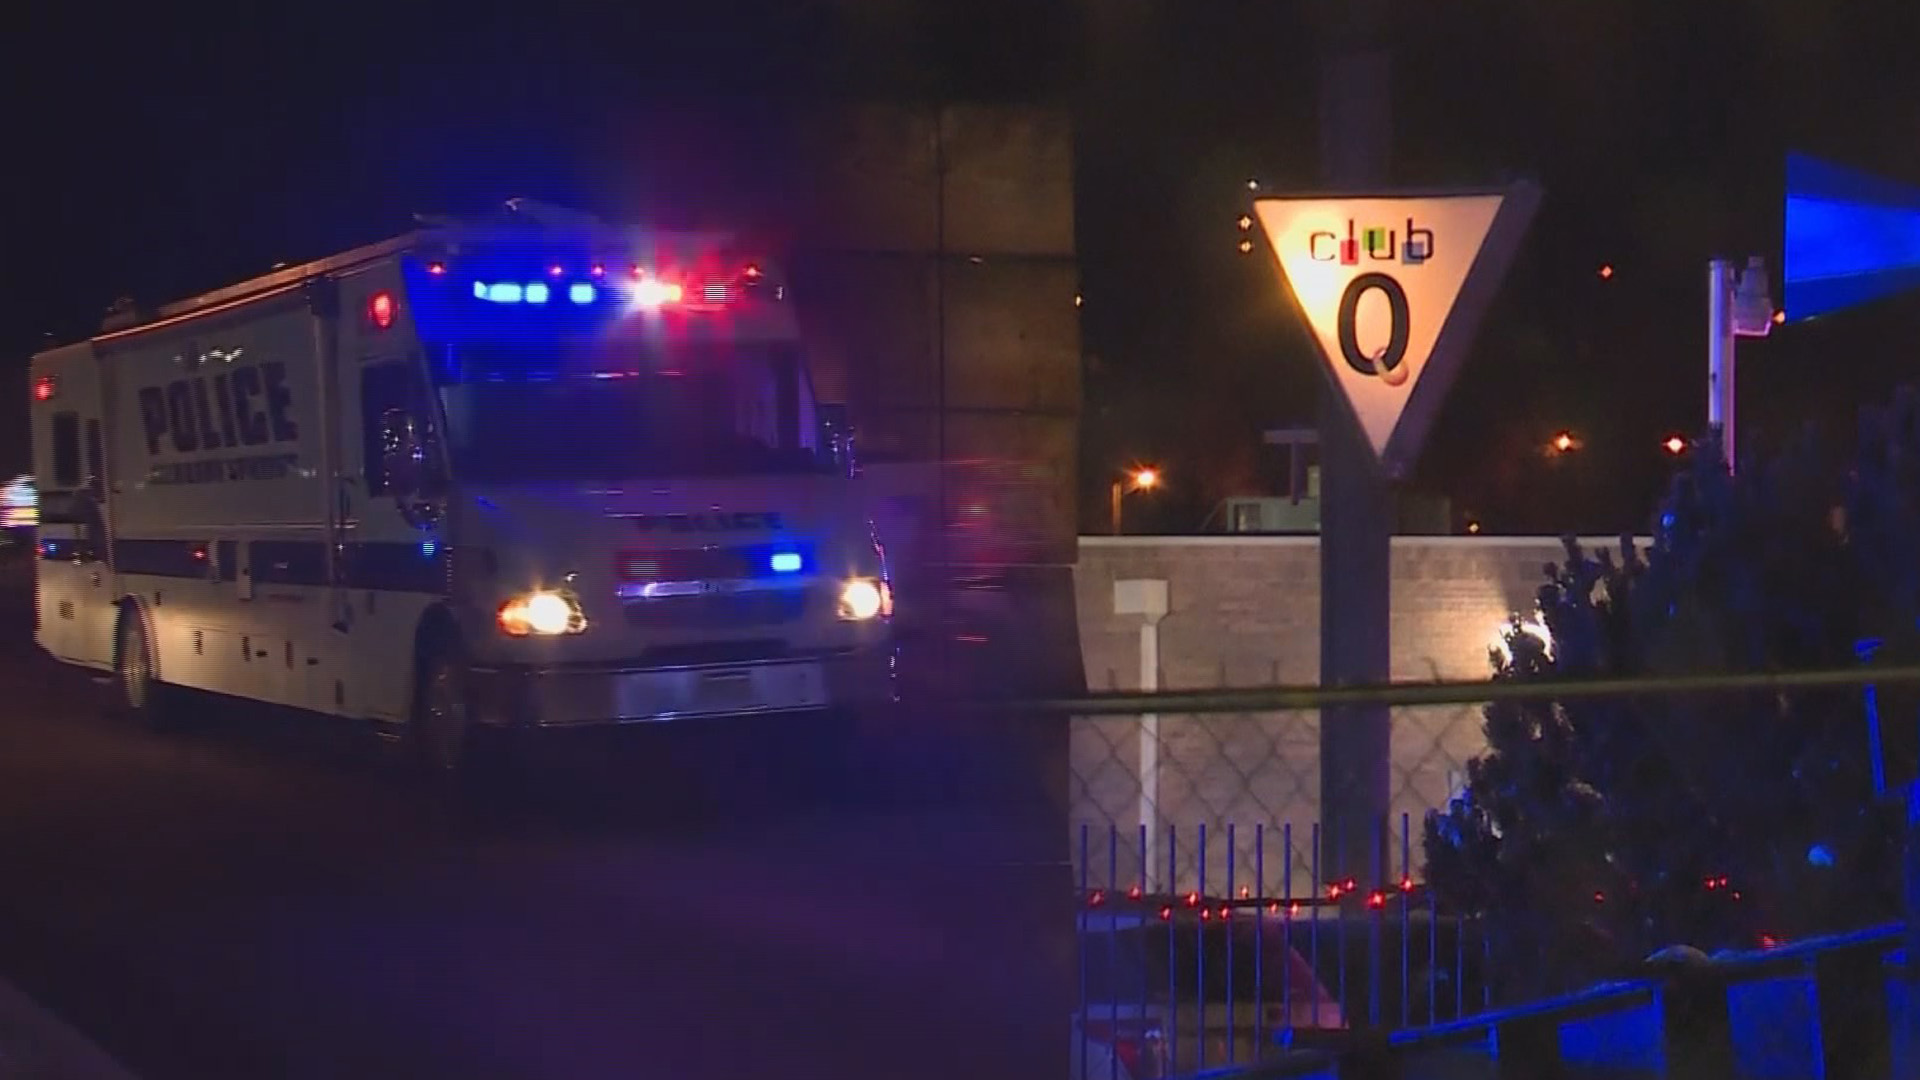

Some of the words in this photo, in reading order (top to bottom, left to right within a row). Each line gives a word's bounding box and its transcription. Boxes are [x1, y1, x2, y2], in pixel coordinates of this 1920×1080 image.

[1310, 217, 1434, 262] club
[1337, 271, 1411, 386] Q
[138, 361, 299, 455] POLICE
